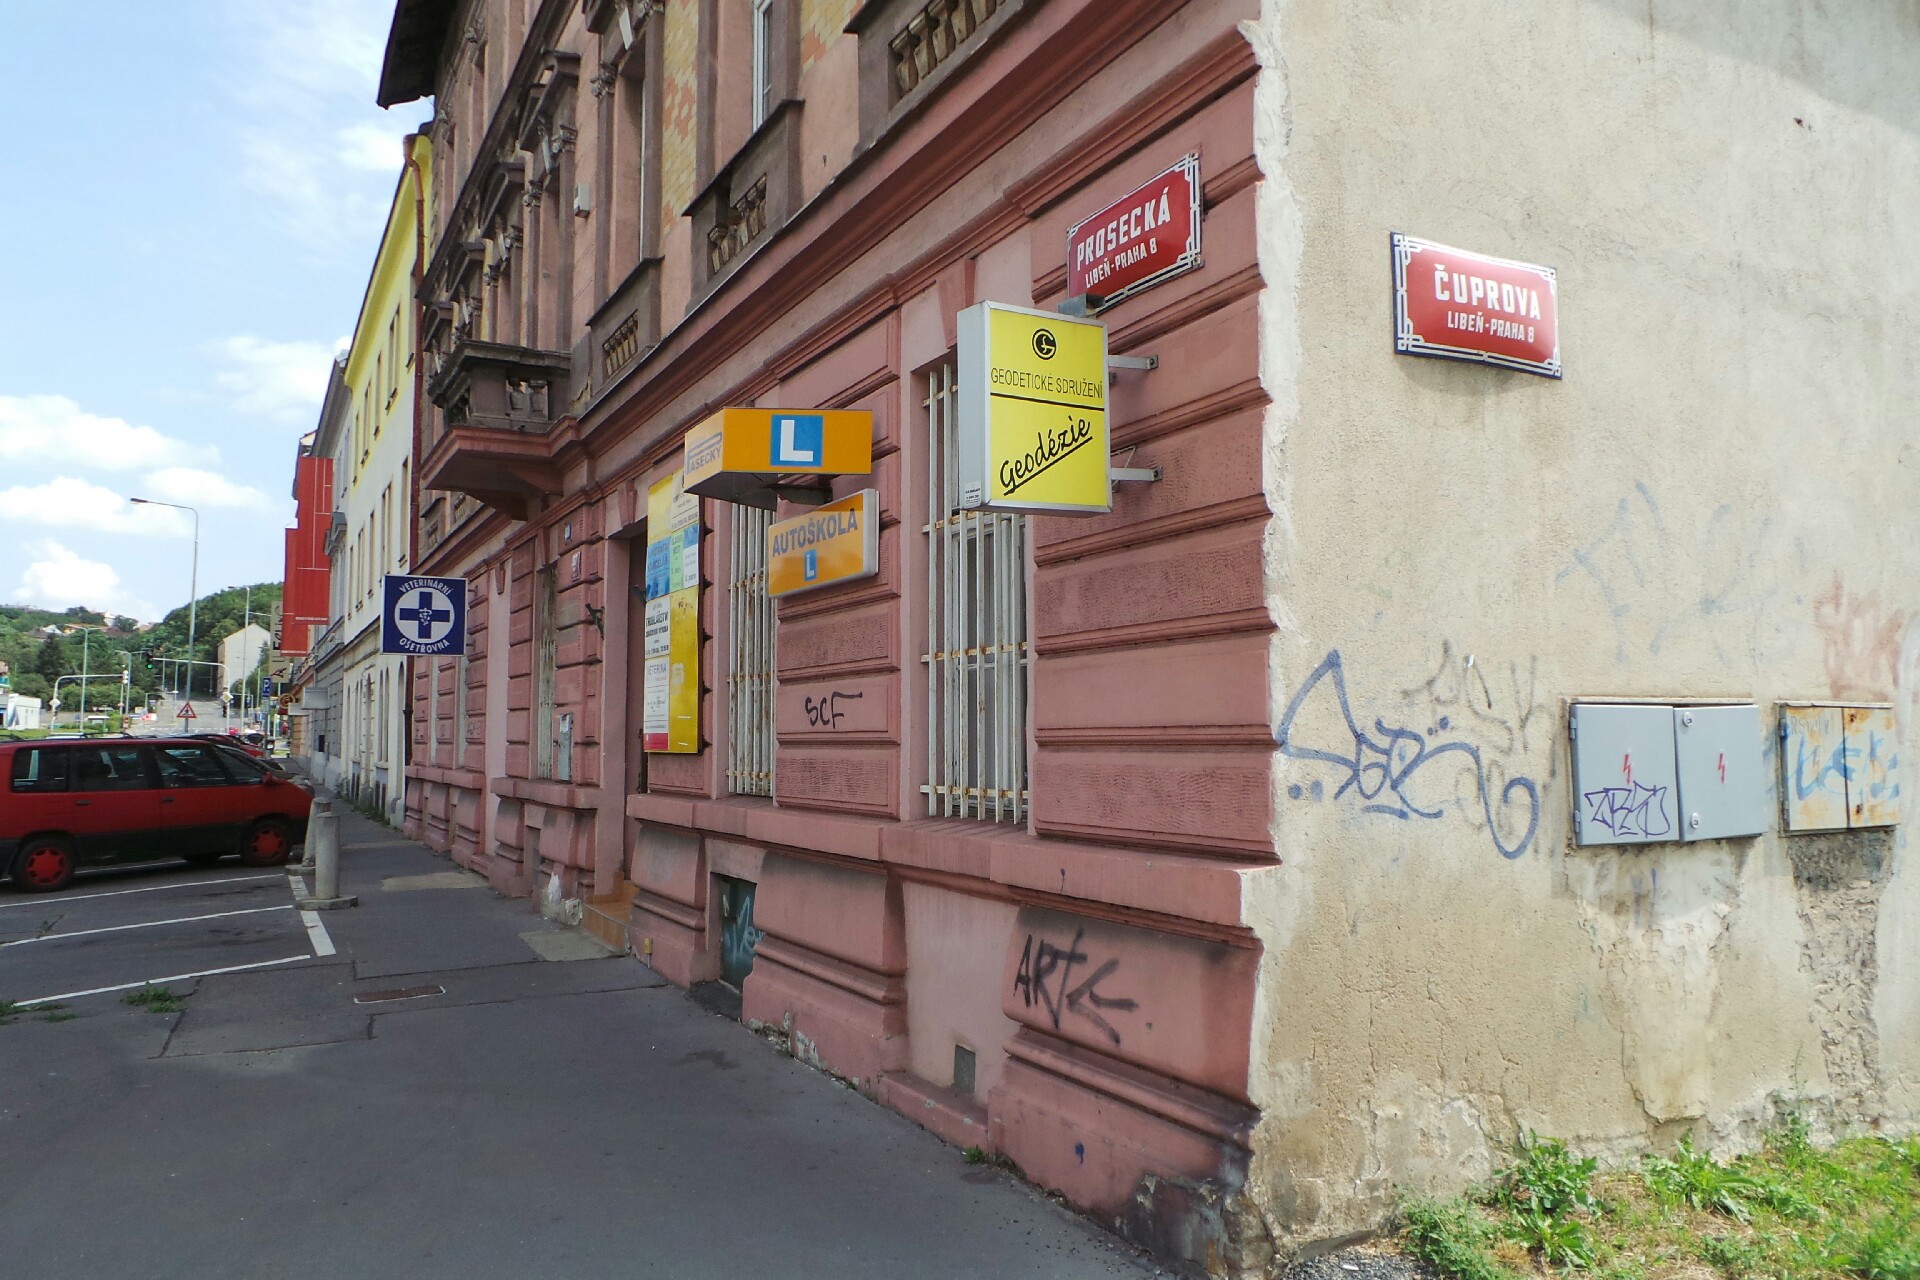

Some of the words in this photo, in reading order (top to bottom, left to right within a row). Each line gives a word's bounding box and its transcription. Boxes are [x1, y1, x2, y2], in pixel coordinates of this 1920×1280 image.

[1076, 186, 1171, 271] PROSECKÁ
[1149, 237, 1158, 254] 8
[1434, 264, 1541, 320] ČUPROVA
[1527, 326, 1535, 343] 8
[991, 367, 1054, 392] GEODETICKÉ
[1056, 377, 1103, 399] SDRUŽENÍ
[780, 420, 814, 462] L
[1000, 415, 1091, 493] Geodézie
[772, 508, 858, 558] AUTOŠKOLA
[806, 554, 815, 578] L
[399, 579, 454, 596] VETERINÁRNÍ
